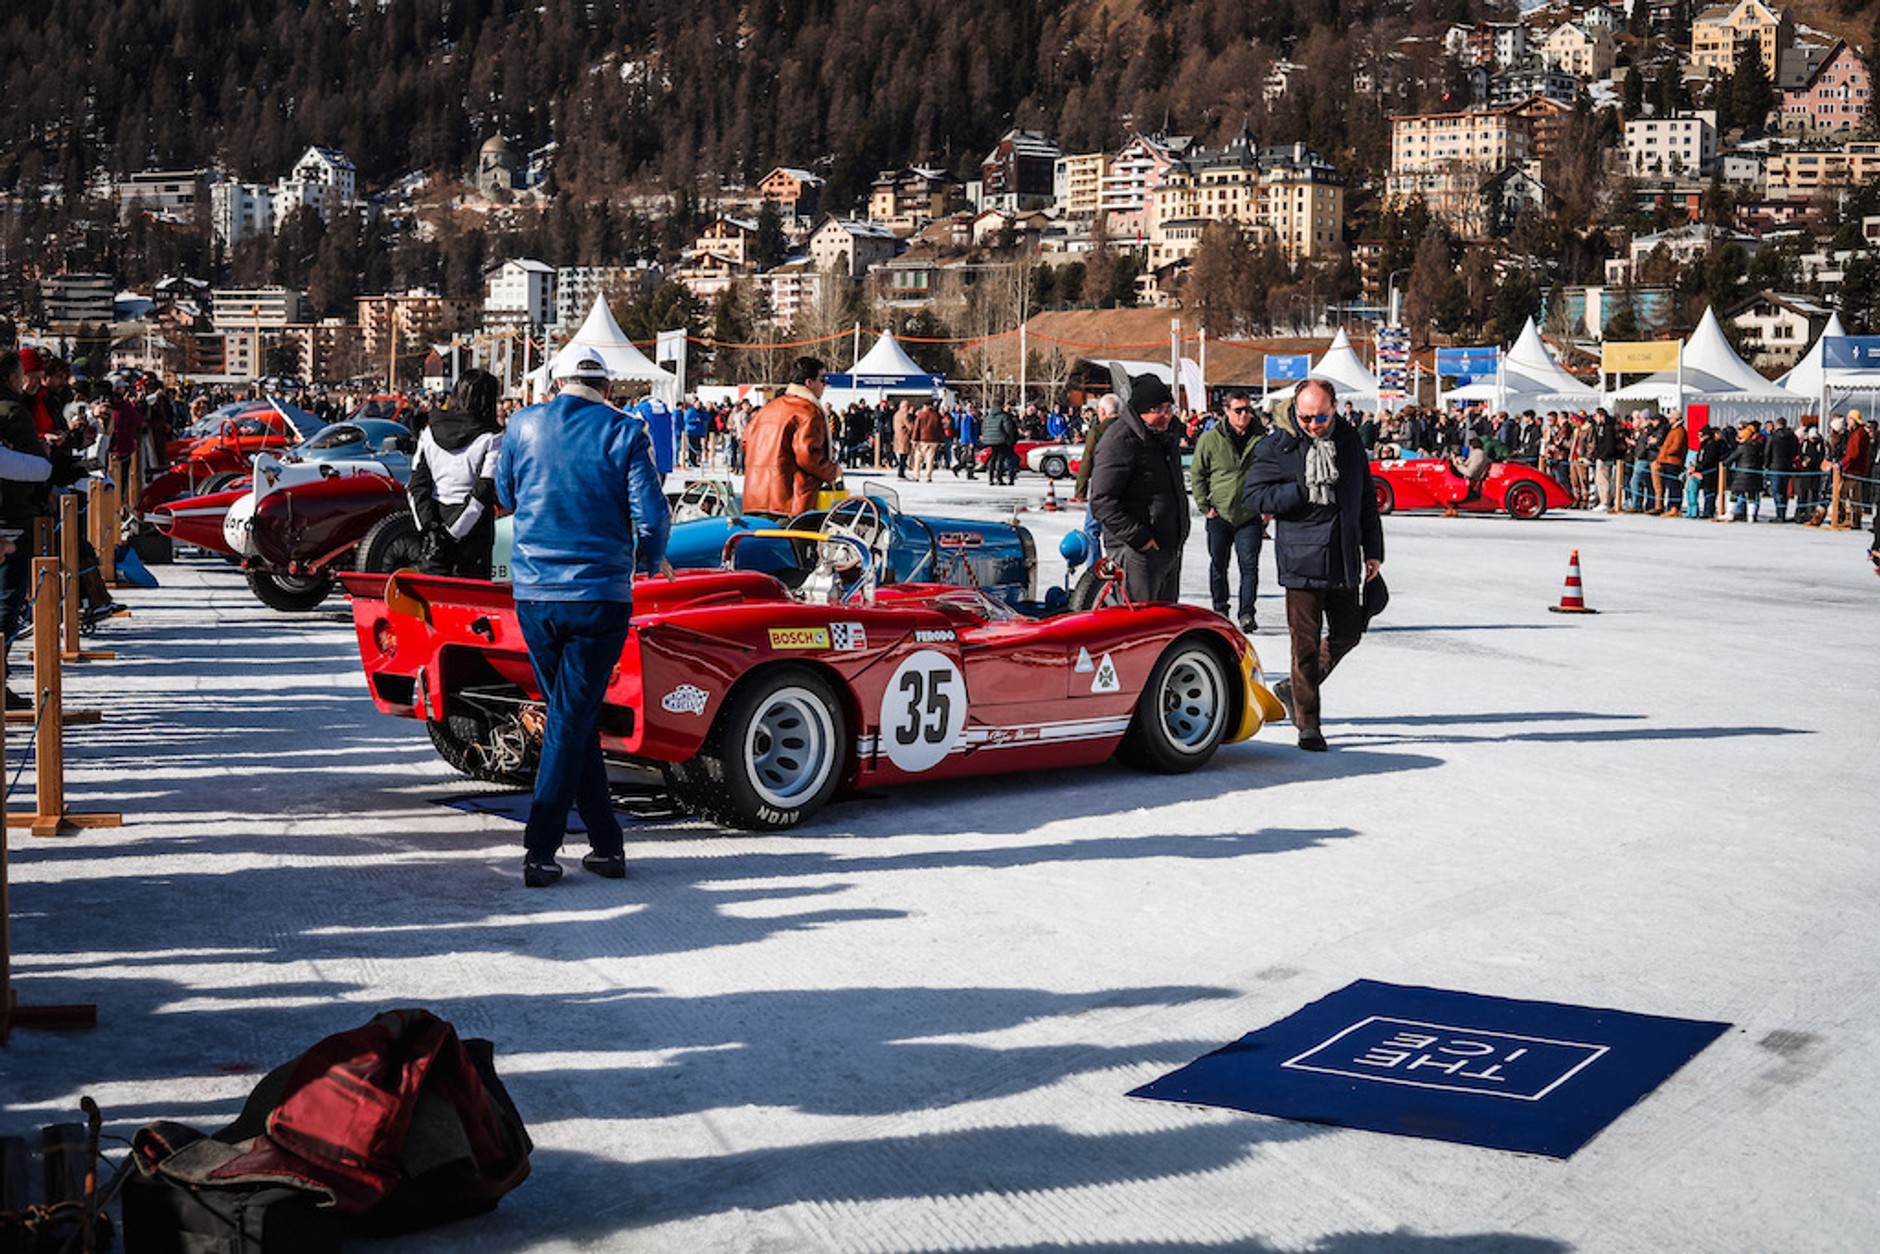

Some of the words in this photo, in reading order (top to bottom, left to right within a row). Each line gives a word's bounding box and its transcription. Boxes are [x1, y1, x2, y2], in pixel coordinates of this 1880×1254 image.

[771, 631, 813, 645] BOSCH
[914, 629, 956, 642] FERODO
[895, 669, 952, 745] 35
[756, 804, 800, 825] AVON
[1382, 1031, 1528, 1063] ICE
[1352, 1046, 1506, 1082] THE
